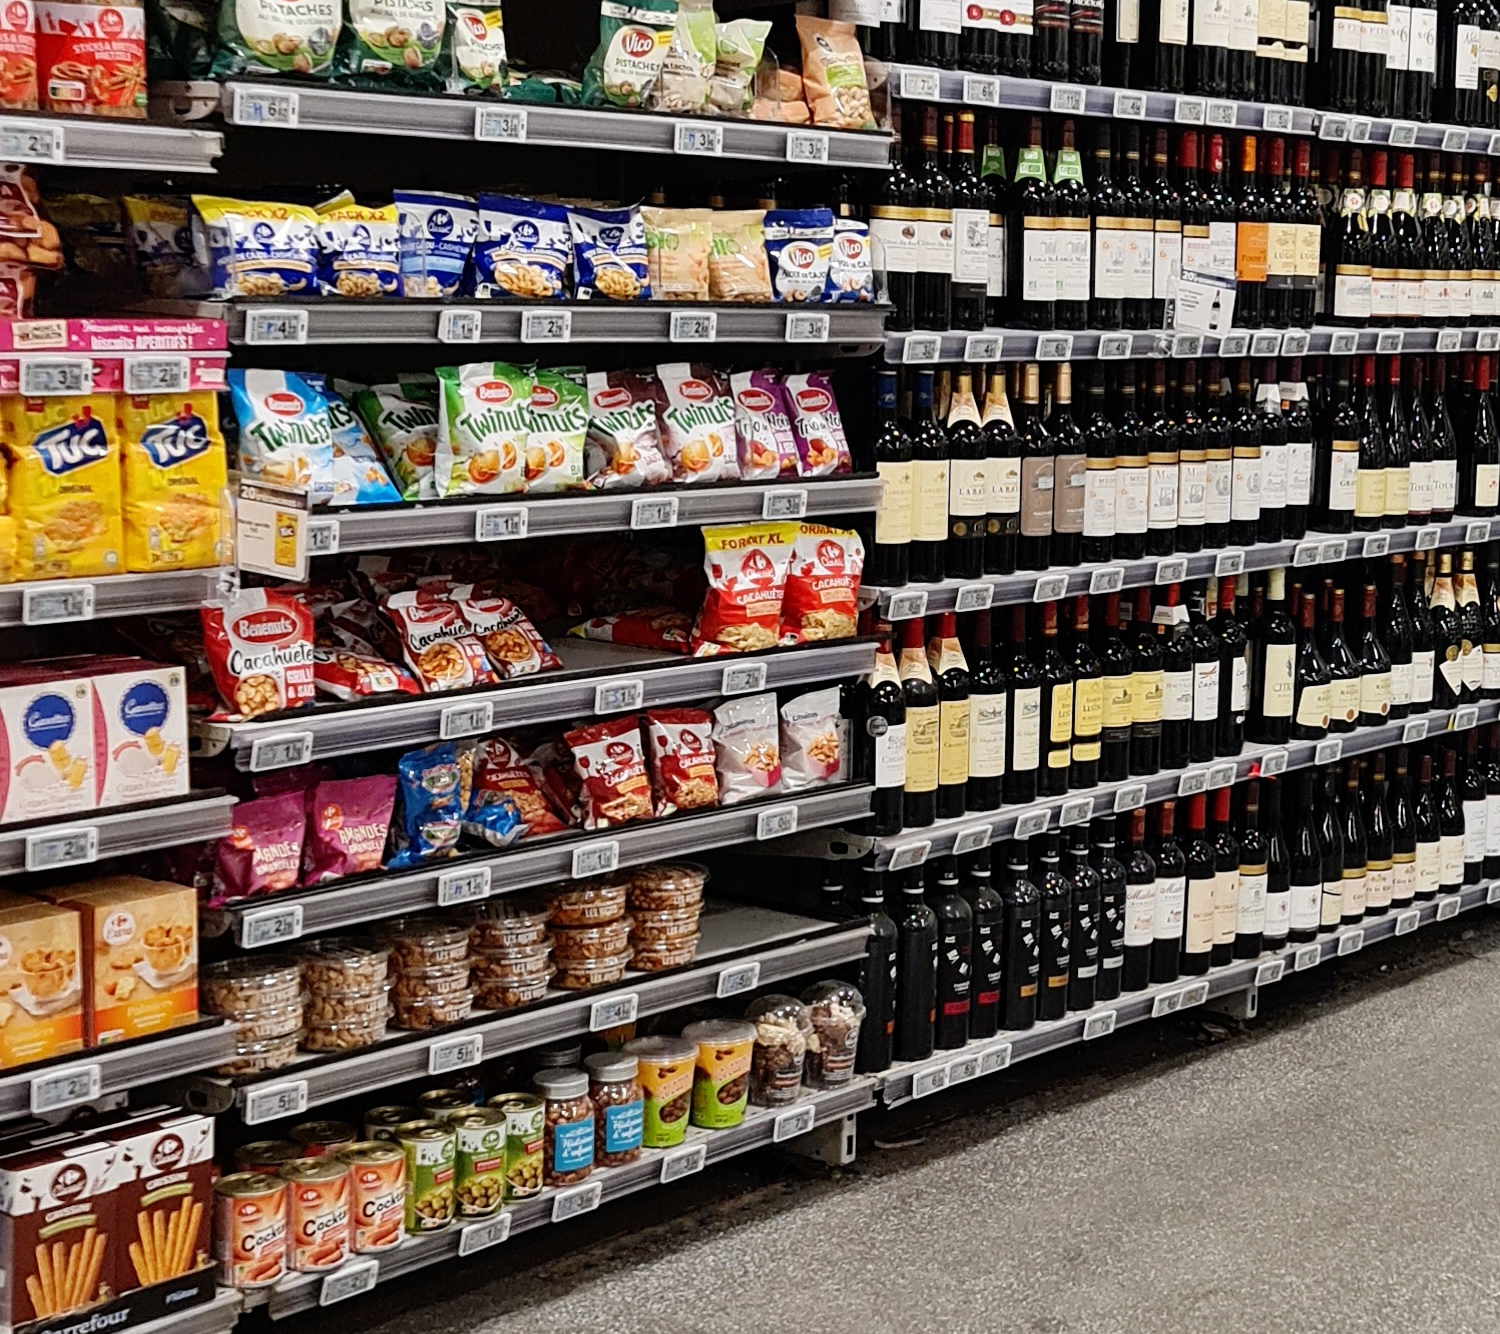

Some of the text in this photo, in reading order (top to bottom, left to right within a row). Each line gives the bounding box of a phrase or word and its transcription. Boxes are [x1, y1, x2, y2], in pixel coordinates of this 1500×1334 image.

[624, 33, 653, 55] Vico
[368, 210, 387, 221] X2
[839, 237, 862, 257] Vico
[790, 250, 815, 268] Vico
[800, 524, 840, 535] ORMAT
[767, 532, 785, 545] XL
